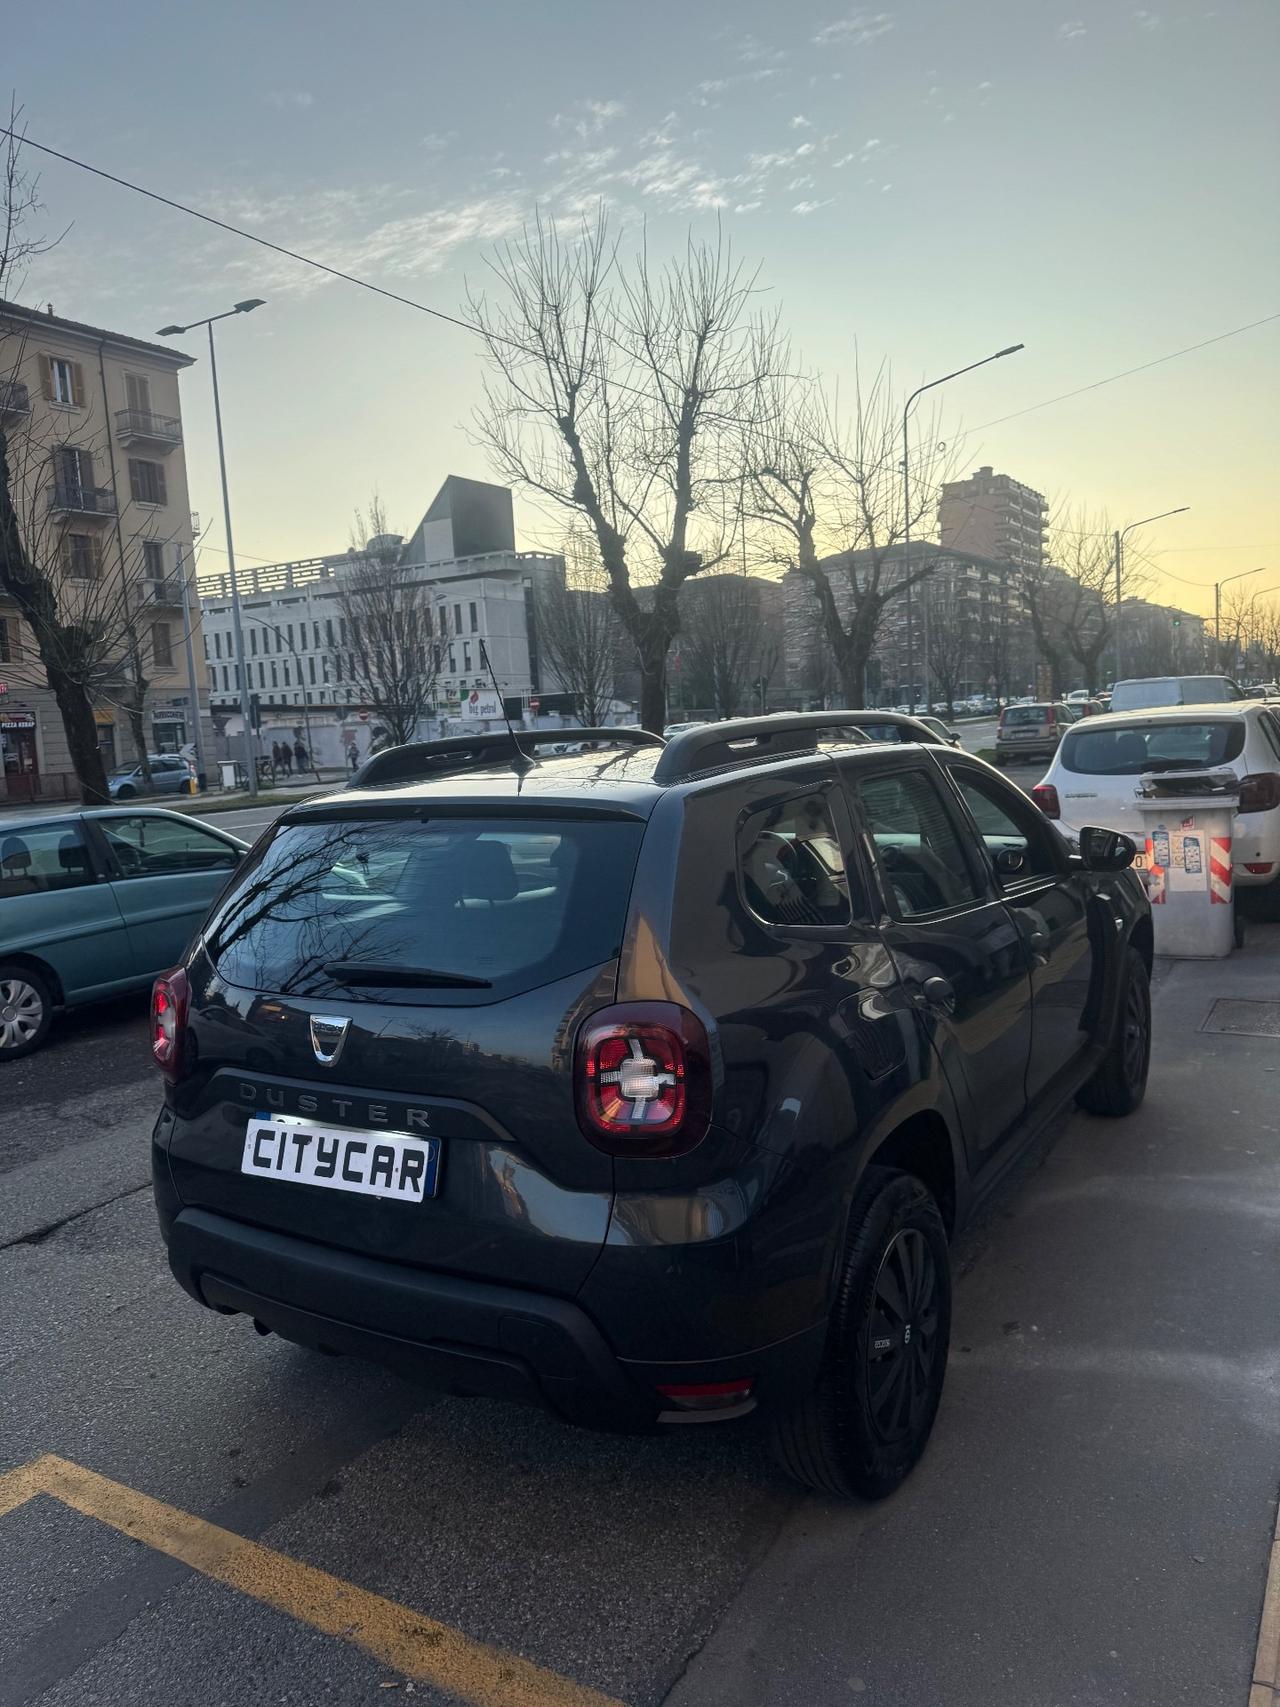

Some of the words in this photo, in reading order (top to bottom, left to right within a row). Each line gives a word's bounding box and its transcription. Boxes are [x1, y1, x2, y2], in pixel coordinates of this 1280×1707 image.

[469, 702, 479, 716] big
[480, 701, 496, 716] petrol
[239, 1083, 430, 1128] DUSTER
[252, 1128, 425, 1193] CITYCAR
